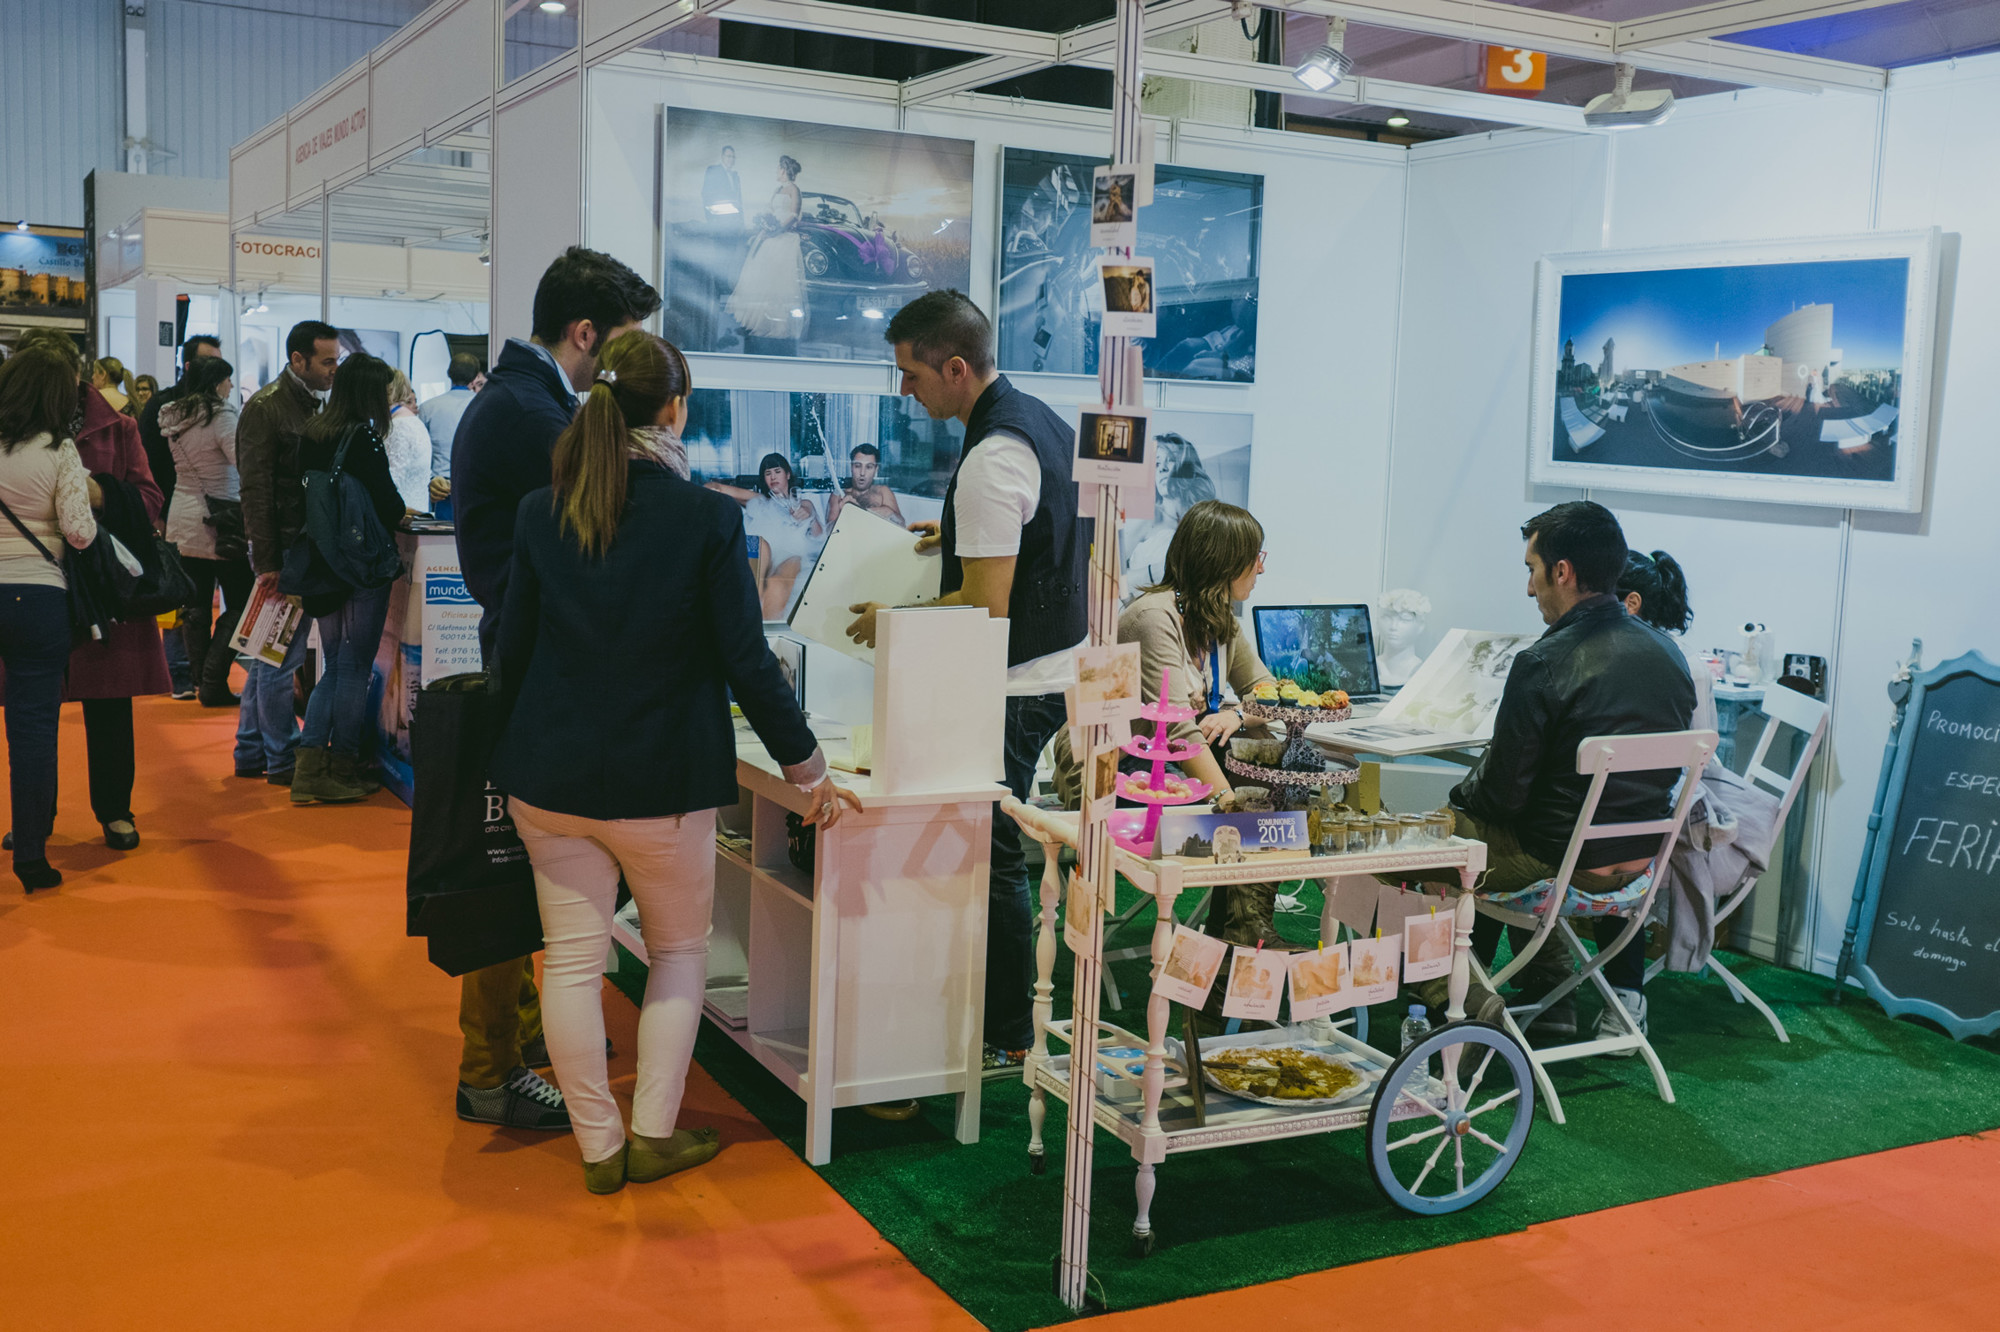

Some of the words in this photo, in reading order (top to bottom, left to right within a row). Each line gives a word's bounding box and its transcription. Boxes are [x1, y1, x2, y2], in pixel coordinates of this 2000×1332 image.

[1501, 49, 1533, 84] 3
[295, 140, 311, 165] AGENCIA
[312, 136, 318, 156] DE
[441, 610, 468, 619] Oficina
[451, 647, 468, 655] 976
[1257, 817, 1296, 826] COMUNIONES
[1259, 825, 1297, 844] 2014
[1885, 911, 1921, 932] Solo
[1930, 919, 1973, 947] hasta
[1913, 947, 1967, 972] domingo
